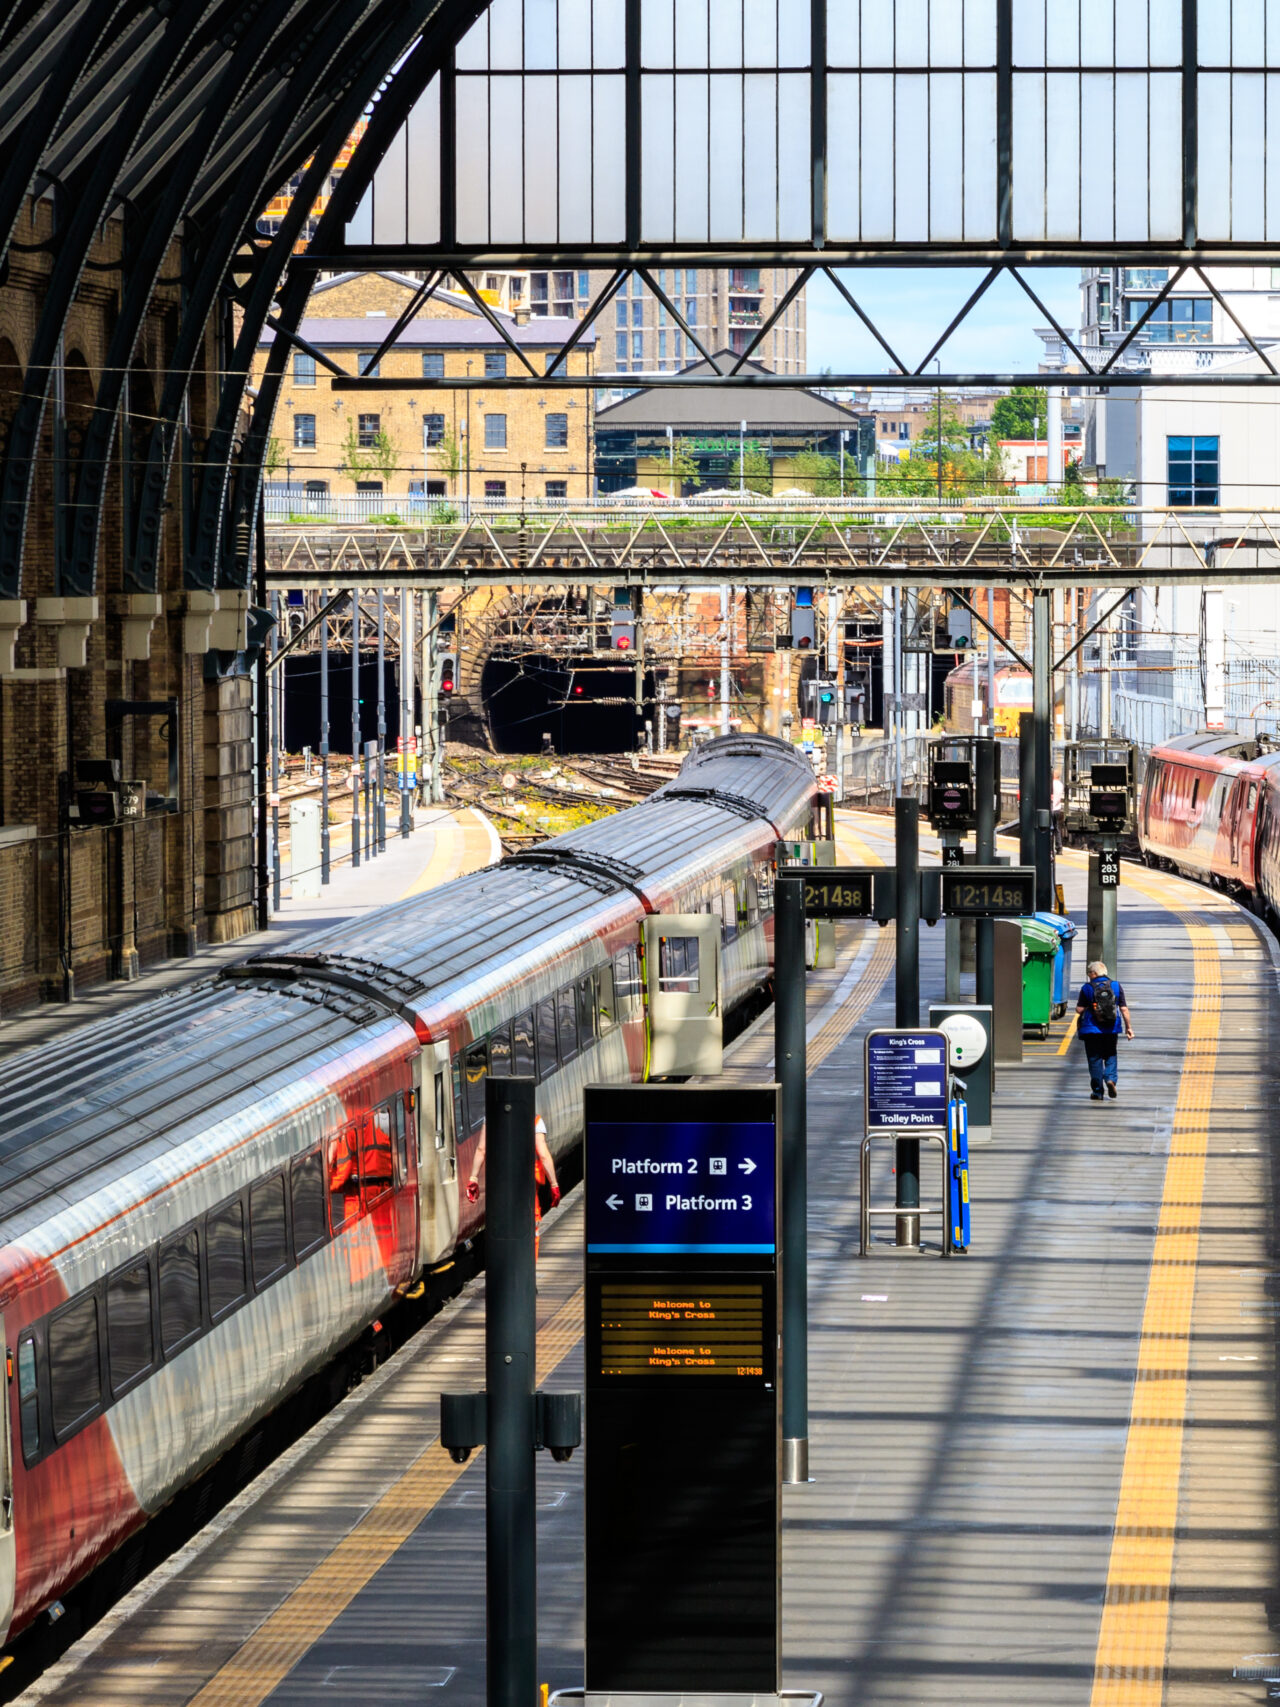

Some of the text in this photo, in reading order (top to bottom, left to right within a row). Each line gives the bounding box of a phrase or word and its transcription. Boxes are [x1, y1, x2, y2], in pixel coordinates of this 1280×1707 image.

[127, 785, 134, 793] K
[122, 796, 139, 804] 279
[123, 807, 137, 815] BR
[949, 849, 956, 858] K
[1105, 854, 1113, 862] K
[1101, 864, 1118, 873] 283
[1102, 875, 1116, 884] BR
[889, 1038, 907, 1046] King's
[880, 1114, 934, 1124] Trolley Point
[611, 1158, 698, 1174] Platform 2
[665, 1194, 752, 1210] Platform 3
[653, 1301, 711, 1309] Welcome to
[649, 1311, 715, 1320] King's Cross
[653, 1347, 711, 1355] Welcome to
[649, 1358, 715, 1366] King's Cross
